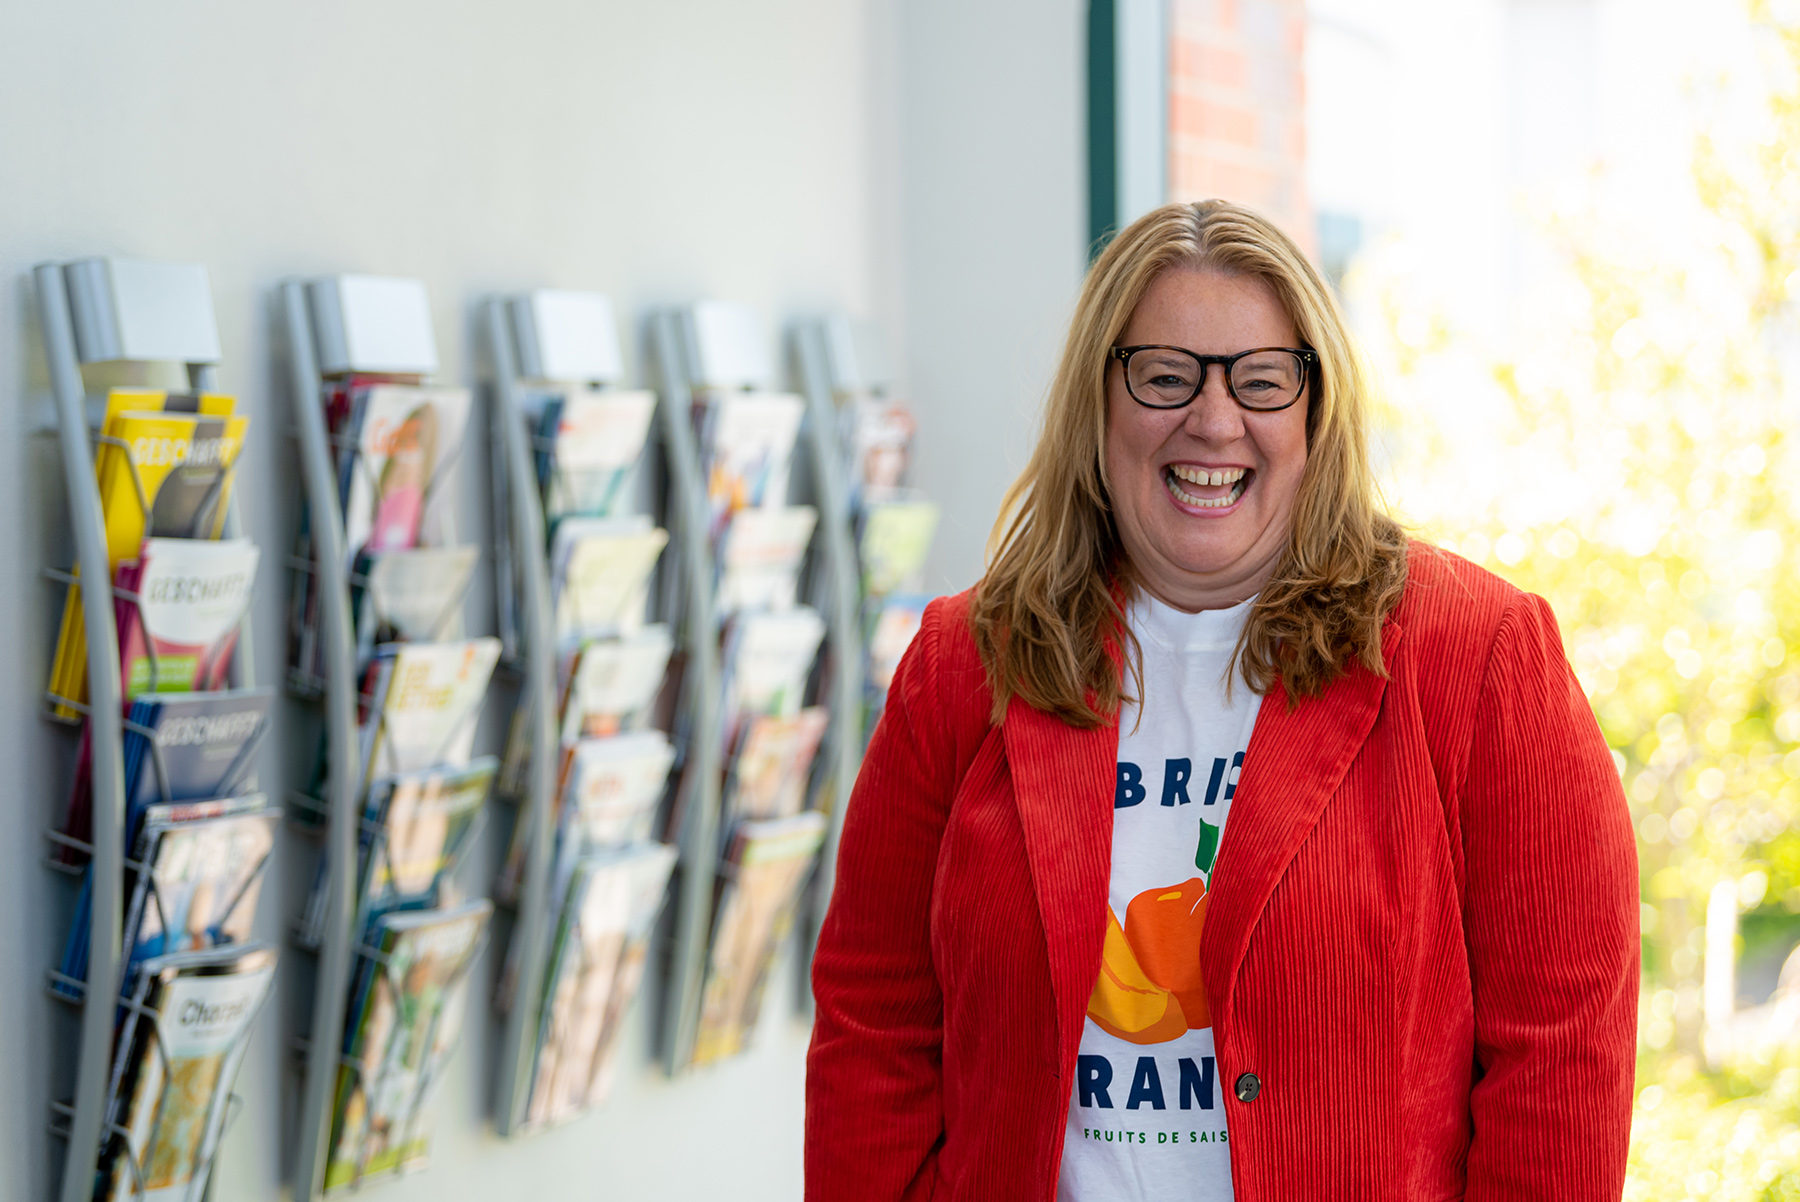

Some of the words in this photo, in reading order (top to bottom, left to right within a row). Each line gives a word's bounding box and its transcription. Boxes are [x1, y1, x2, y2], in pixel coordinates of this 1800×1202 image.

[1077, 1055, 1214, 1110] RAN
[1084, 1128, 1146, 1144] FRUITS
[1157, 1131, 1179, 1144] DE
[1190, 1130, 1228, 1143] SAIS
